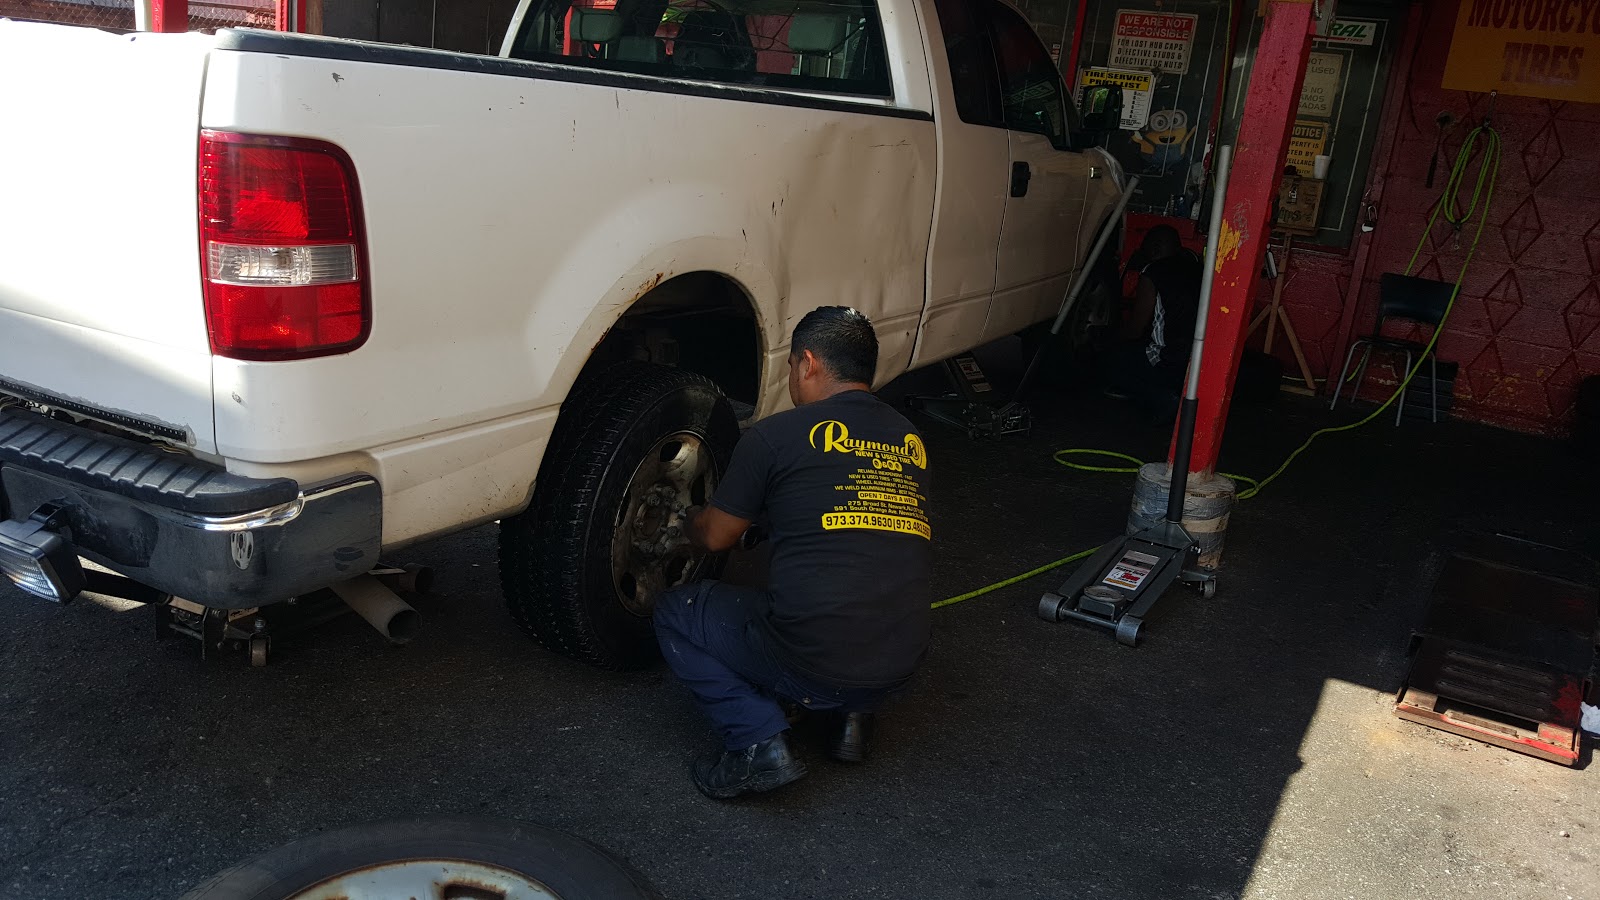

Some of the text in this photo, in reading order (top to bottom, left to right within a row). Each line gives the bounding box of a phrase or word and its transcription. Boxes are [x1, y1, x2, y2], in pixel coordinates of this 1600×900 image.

[1124, 15, 1188, 28] WE ARE NOT
[1118, 25, 1189, 39] RESPONSIBLE
[1117, 38, 1130, 46] FOR
[1131, 40, 1148, 48] LOST
[1150, 41, 1162, 49] HUB
[1153, 50, 1175, 59] STUDS
[1150, 59, 1162, 68] LUG
[1164, 60, 1183, 69] NUTS
[1501, 42, 1584, 82] TIRES
[1311, 67, 1335, 75] USED
[1107, 73, 1149, 82] SERVICE
[855, 450, 874, 458] NEW
[881, 453, 898, 461] USED
[899, 456, 911, 465] TIRE
